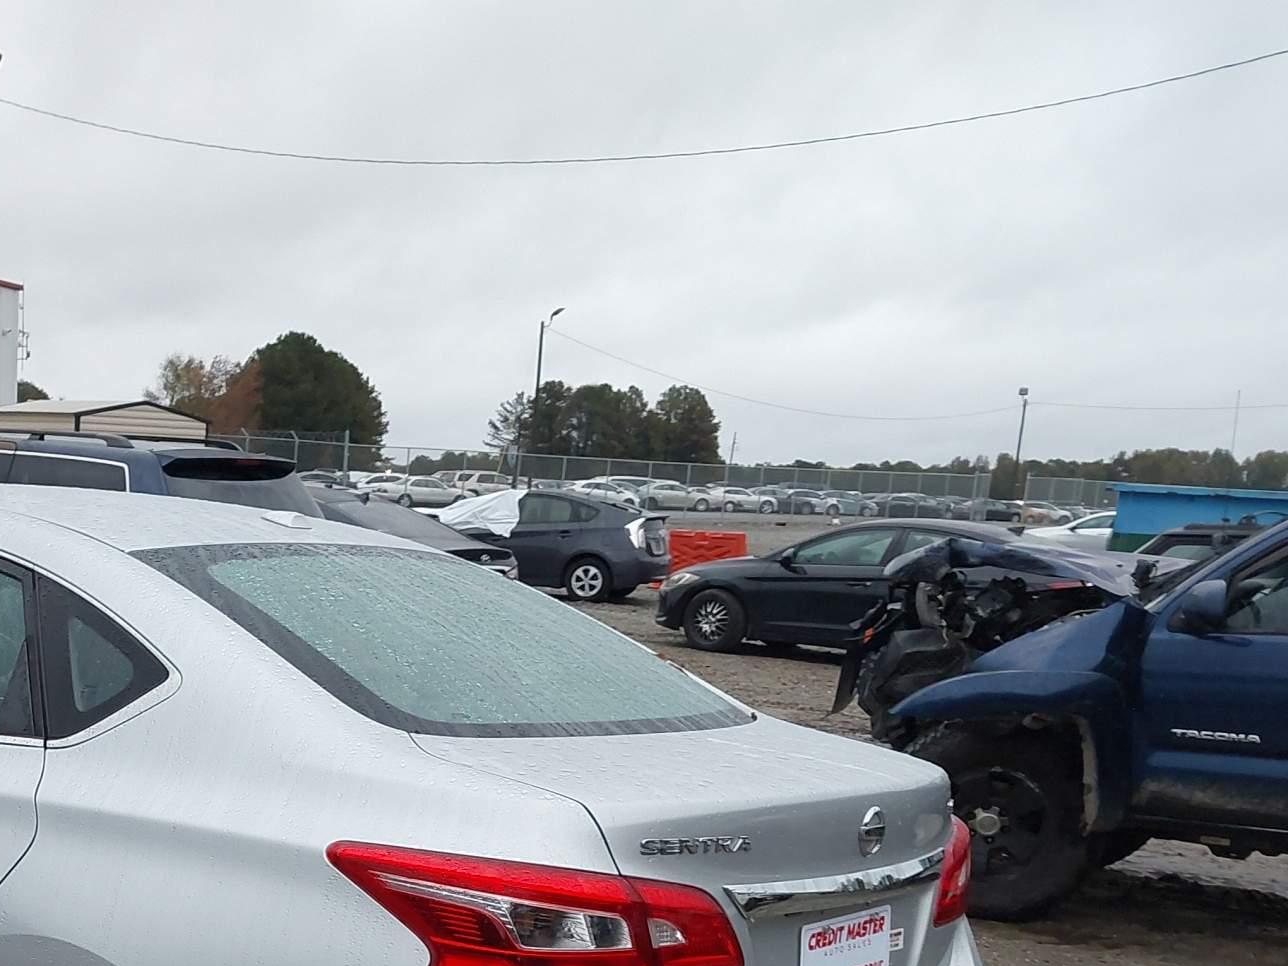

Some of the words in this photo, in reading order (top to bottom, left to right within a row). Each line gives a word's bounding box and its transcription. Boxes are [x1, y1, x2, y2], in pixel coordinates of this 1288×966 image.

[1170, 728, 1261, 743] TACOMA
[639, 835, 752, 855] SENTRA
[808, 926, 844, 951] CREDIT
[846, 915, 885, 942] MASTER
[824, 946, 844, 956] AUTO
[848, 939, 872, 950] SALES
